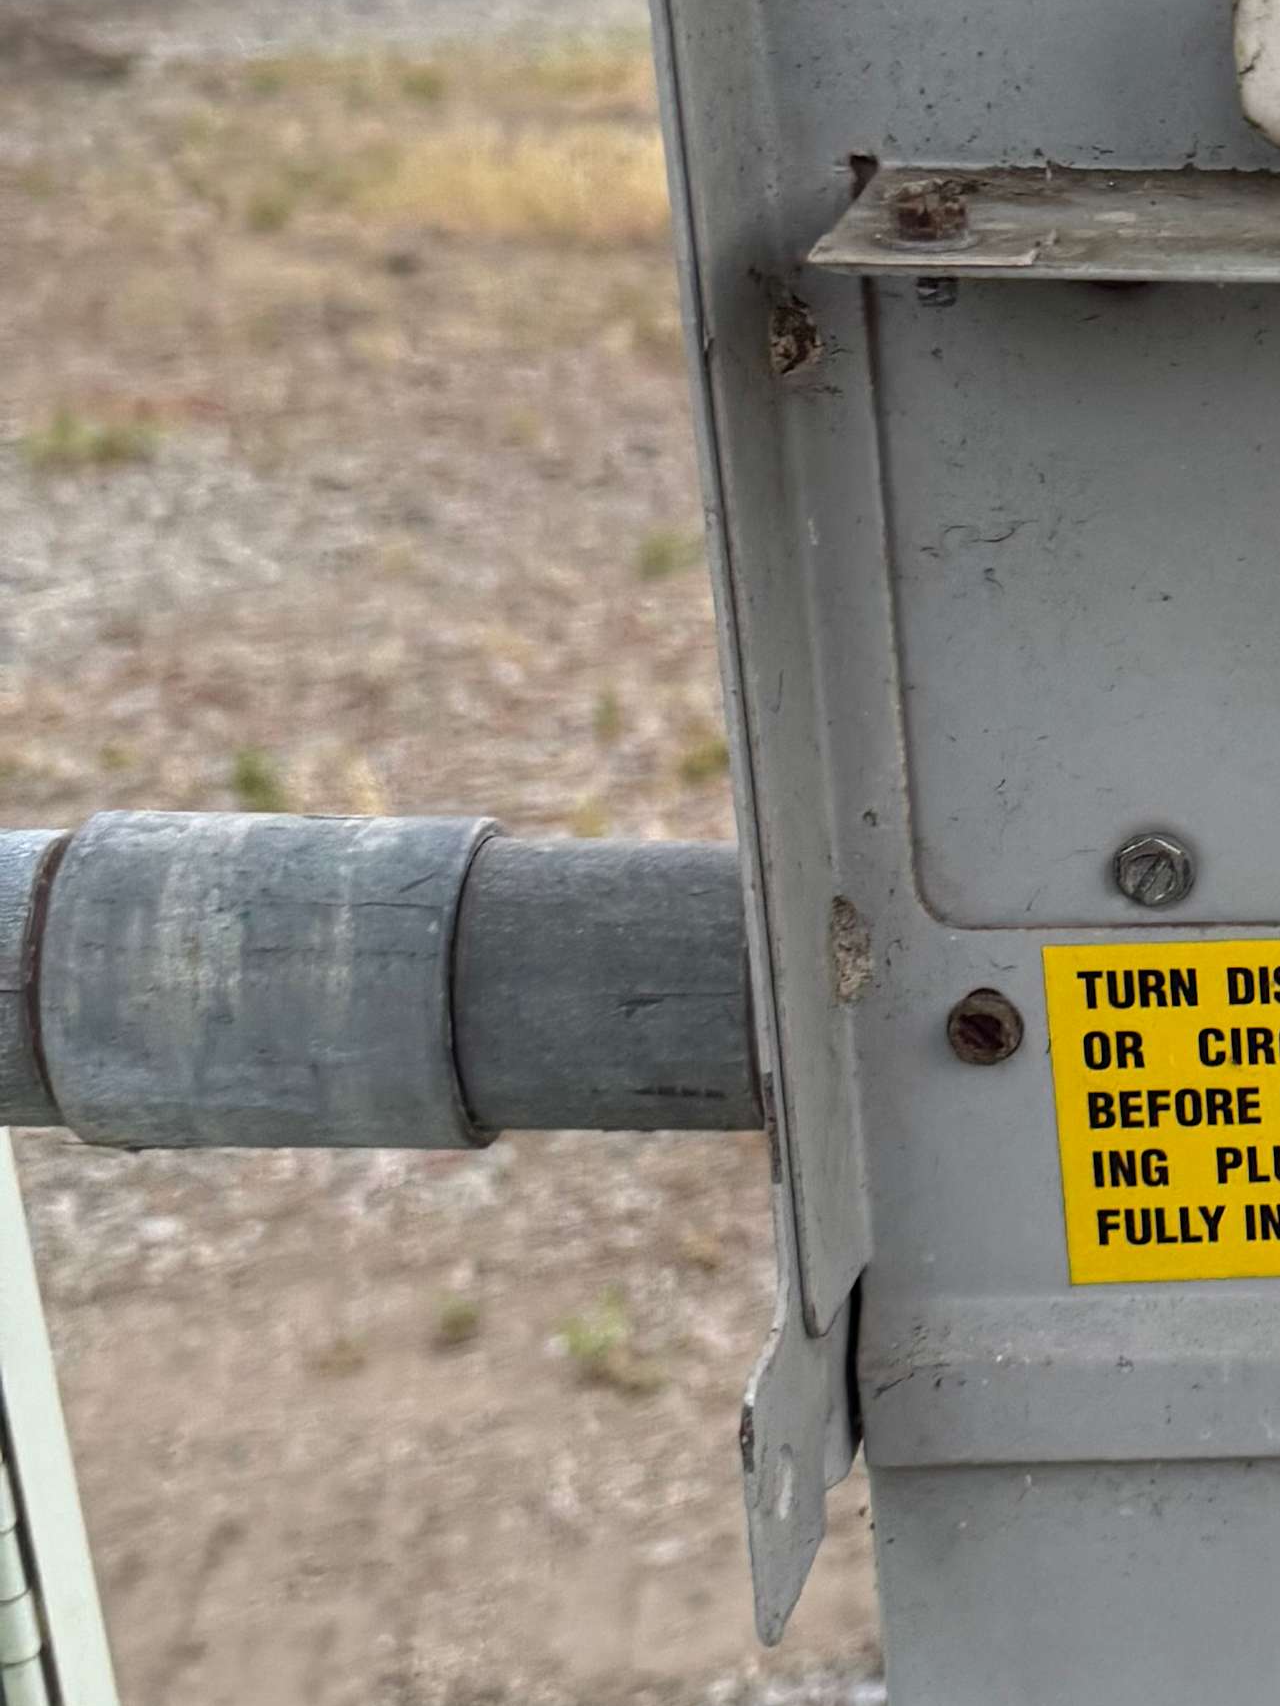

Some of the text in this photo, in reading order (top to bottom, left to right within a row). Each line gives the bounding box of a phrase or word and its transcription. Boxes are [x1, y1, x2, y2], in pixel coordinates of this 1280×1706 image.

[1076, 967, 1199, 1010] TURN
[1083, 1030, 1145, 1071] OR
[1087, 1085, 1262, 1130] BEFORE
[1092, 1148, 1170, 1188] ING
[1096, 1205, 1226, 1246] FULLY
